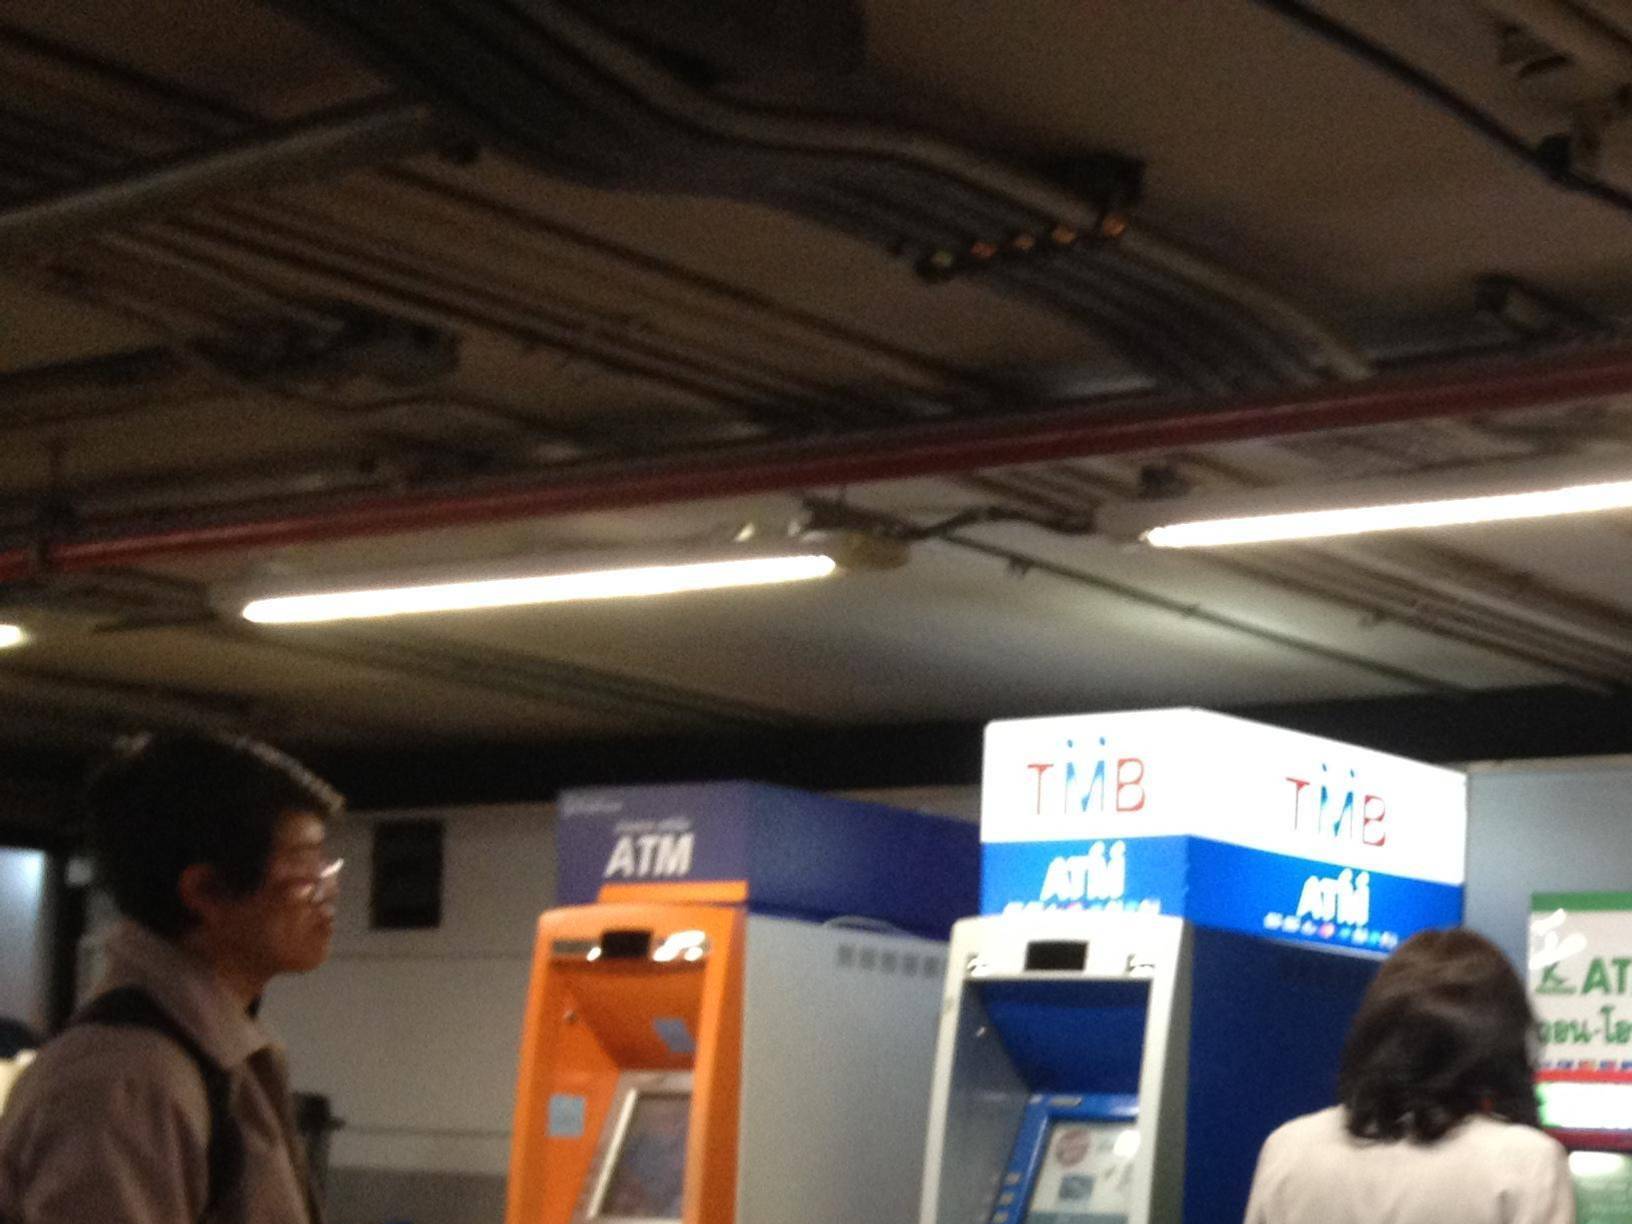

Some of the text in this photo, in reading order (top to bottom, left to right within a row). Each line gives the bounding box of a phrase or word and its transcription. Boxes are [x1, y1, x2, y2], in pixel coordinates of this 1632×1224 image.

[1027, 737, 1146, 815] TMB
[1286, 763, 1387, 848] TMB
[604, 832, 695, 879] ATM
[1040, 841, 1126, 901] ATM
[1297, 868, 1370, 926] ATM
